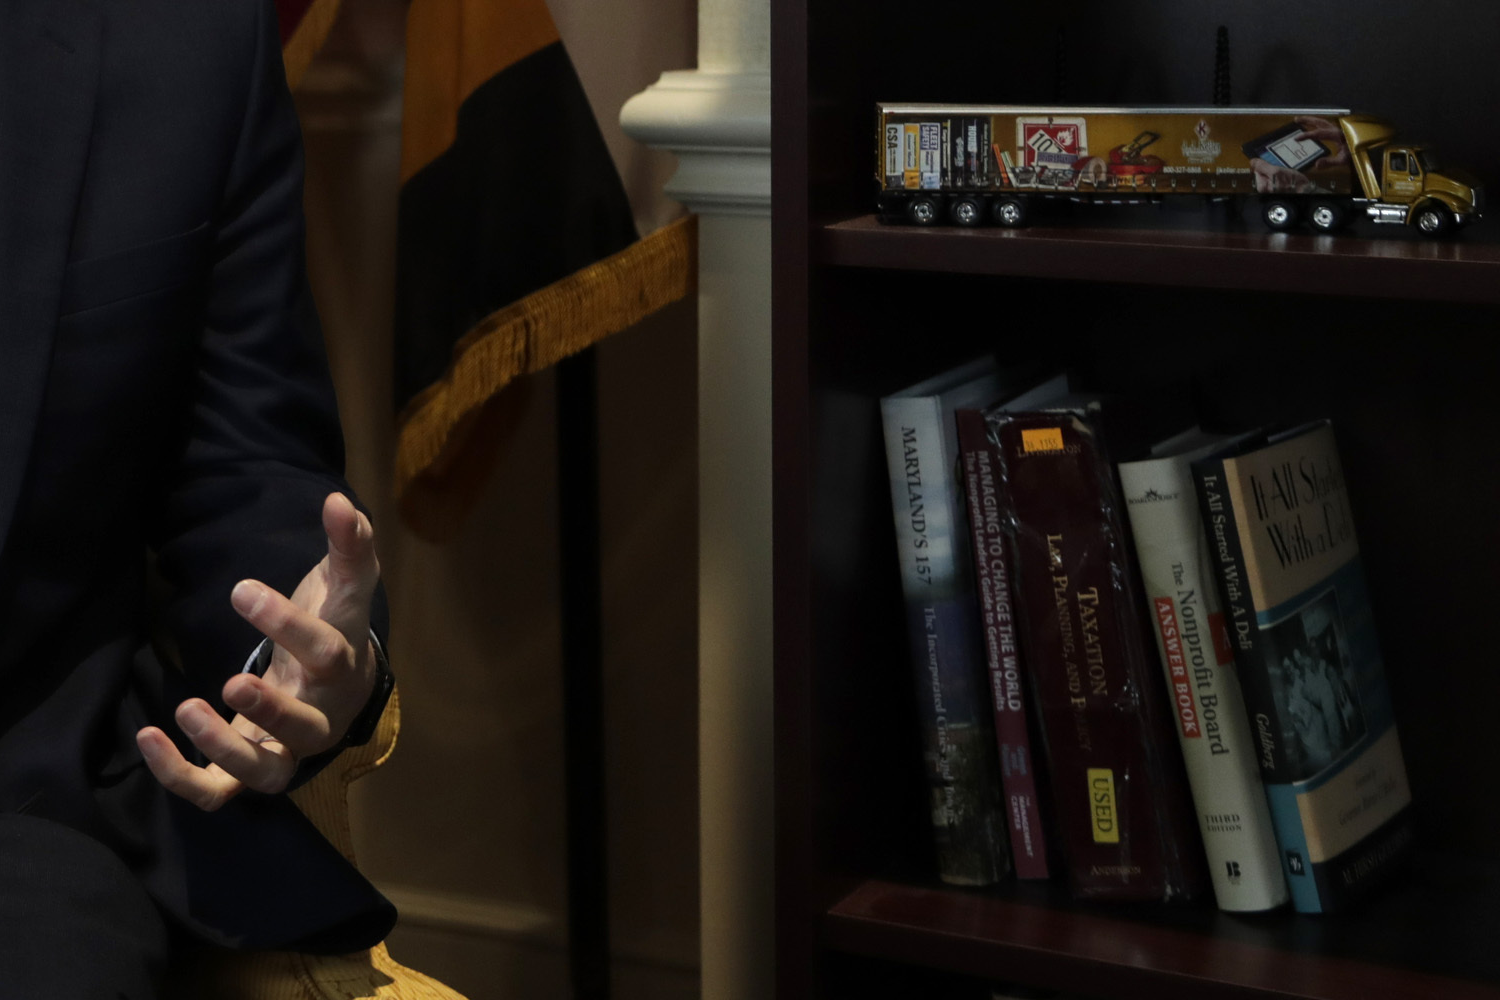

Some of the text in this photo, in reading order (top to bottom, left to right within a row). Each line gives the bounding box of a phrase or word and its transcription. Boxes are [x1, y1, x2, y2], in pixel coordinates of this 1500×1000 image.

[887, 126, 898, 149] CSA
[922, 126, 930, 149] SAFETY
[930, 126, 938, 149] FLEET
[967, 125, 977, 152] HOURS
[1198, 122, 1206, 136] K
[902, 427, 931, 585] MARYLAND'S 157
[1271, 461, 1299, 515] All
[1204, 474, 1253, 650] It All Started With A Deli
[1267, 513, 1314, 570] With
[965, 451, 1005, 712] The Nonprofit Leader's Guide to Getting Results
[978, 450, 1021, 711] MANAGING TO CHANGE THE WORLD
[924, 607, 936, 633] The
[1077, 587, 1108, 696] TAXATION
[926, 634, 947, 714] Incorporated
[1066, 662, 1081, 692] AND
[1158, 601, 1198, 734] ANSWER BOOK
[1172, 562, 1230, 756] The Nonprofit Board
[1255, 713, 1276, 770] Goldberg
[1011, 796, 1020, 830] CENTER
[1019, 796, 1034, 858] MANAGEMENT
[1092, 776, 1113, 833] USED
[1205, 813, 1241, 824] THIRD
[1207, 824, 1243, 833] EDITION
